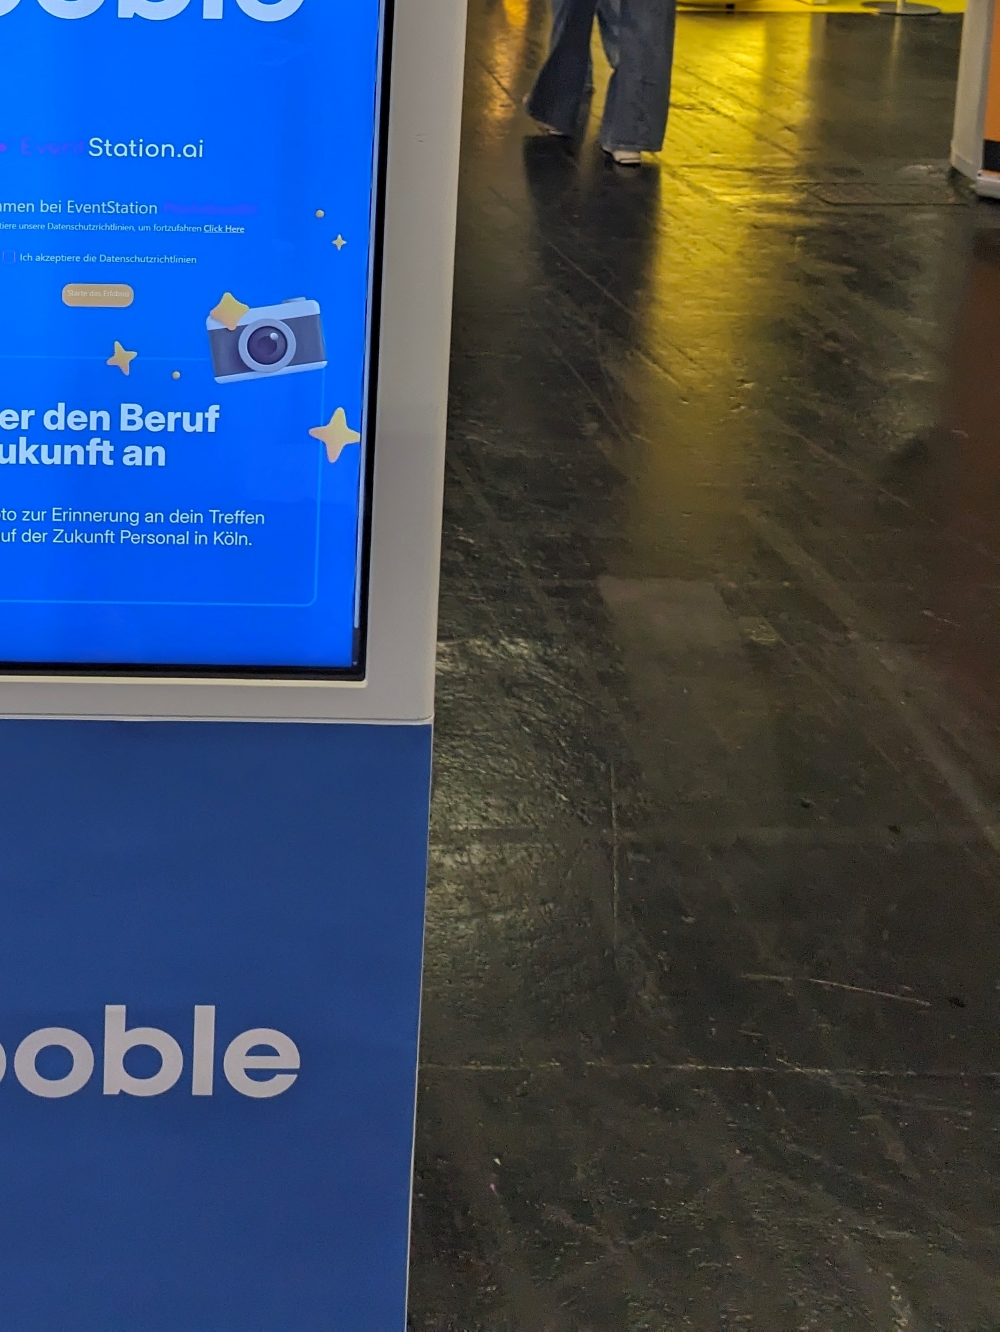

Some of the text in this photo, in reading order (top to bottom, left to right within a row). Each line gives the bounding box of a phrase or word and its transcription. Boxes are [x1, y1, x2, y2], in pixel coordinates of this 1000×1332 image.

[40, 199, 62, 213] bei
[67, 200, 158, 214] EventStation
[47, 222, 136, 232] Datenschutzrichtlinien,
[153, 224, 202, 233] fortzufahren
[203, 224, 223, 233] Click
[224, 224, 245, 234] Here
[20, 253, 197, 264] Ich akzeptiere die Datenschutzrichtlinien
[43, 402, 110, 431] den
[120, 403, 220, 433] Beruf
[122, 445, 166, 466] an
[21, 511, 47, 522] zur
[52, 508, 140, 526] Erinnerung
[144, 512, 164, 523] an
[169, 509, 204, 524] dein
[208, 509, 265, 525] Treffen
[21, 528, 48, 543] der
[52, 528, 115, 544] Zukunft
[120, 530, 190, 545] Personal
[194, 531, 208, 545] in
[213, 531, 253, 546] Köln.
